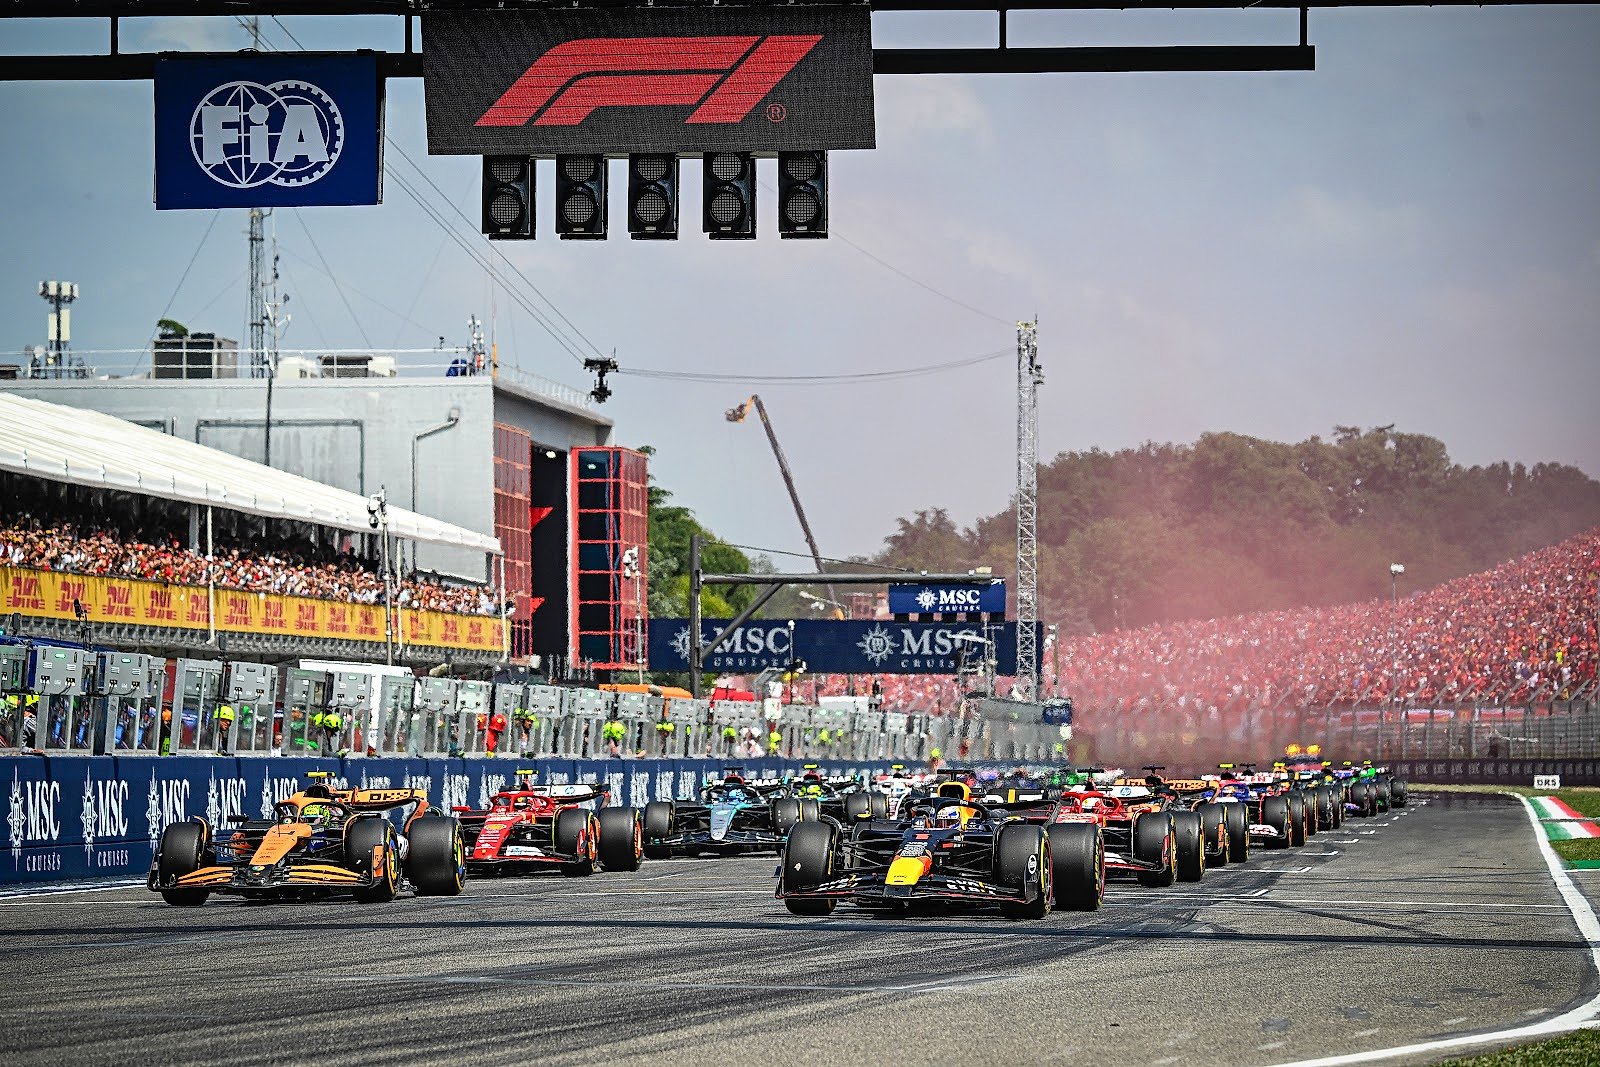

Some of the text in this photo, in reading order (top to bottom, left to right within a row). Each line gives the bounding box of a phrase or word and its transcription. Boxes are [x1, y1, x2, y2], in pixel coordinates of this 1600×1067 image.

[473, 35, 824, 127] F1
[939, 590, 980, 604] MSC
[713, 627, 790, 655] MSC
[1537, 779, 1557, 787] DRS
[27, 780, 61, 841] MSC
[98, 778, 129, 837] MSC
[26, 851, 61, 872] CRUISES
[97, 850, 129, 867] CRUISES
